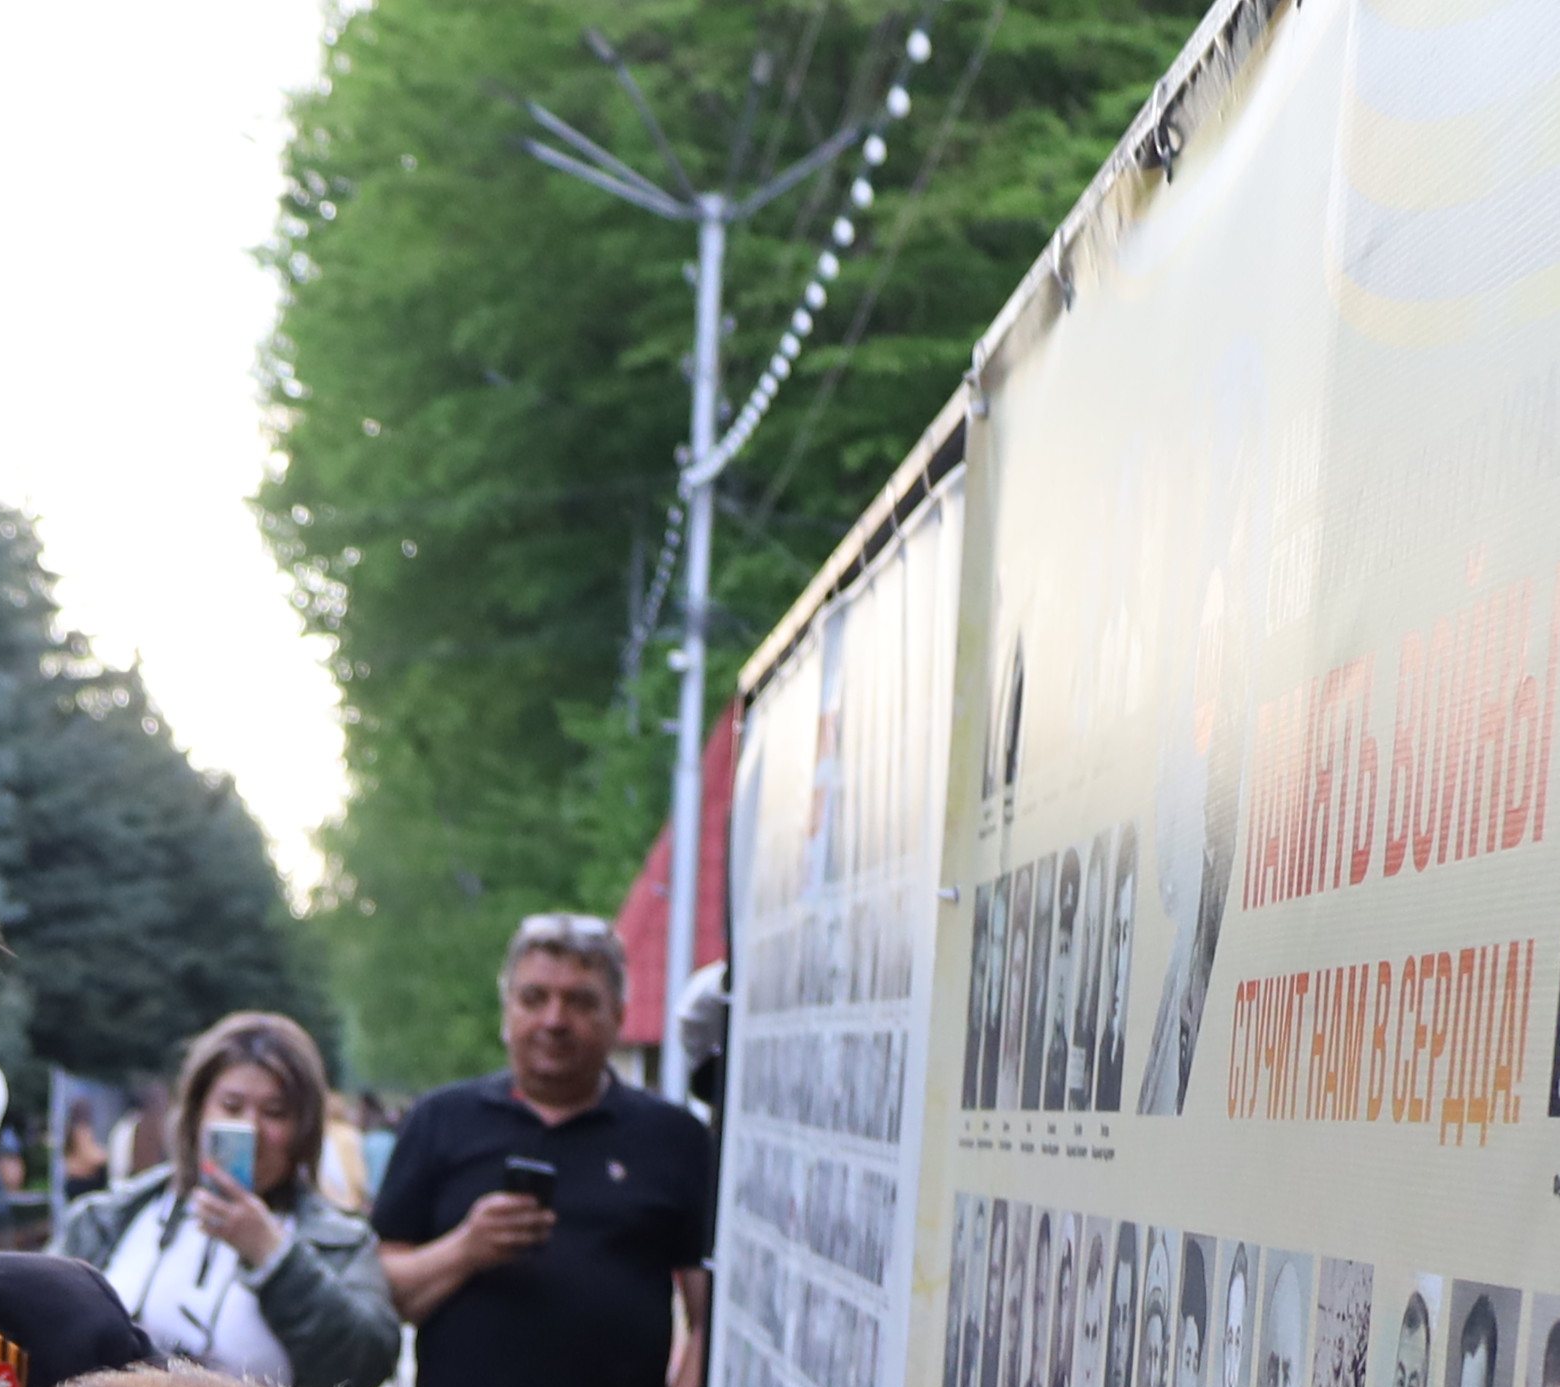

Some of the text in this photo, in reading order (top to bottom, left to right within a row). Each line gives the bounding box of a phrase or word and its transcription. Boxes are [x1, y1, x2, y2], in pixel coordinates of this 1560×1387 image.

[1242, 650, 1379, 911] ПАМЯТЬ
[1226, 938, 1536, 1148] СТУЧИТ НАМ В СЕРДЦА!
